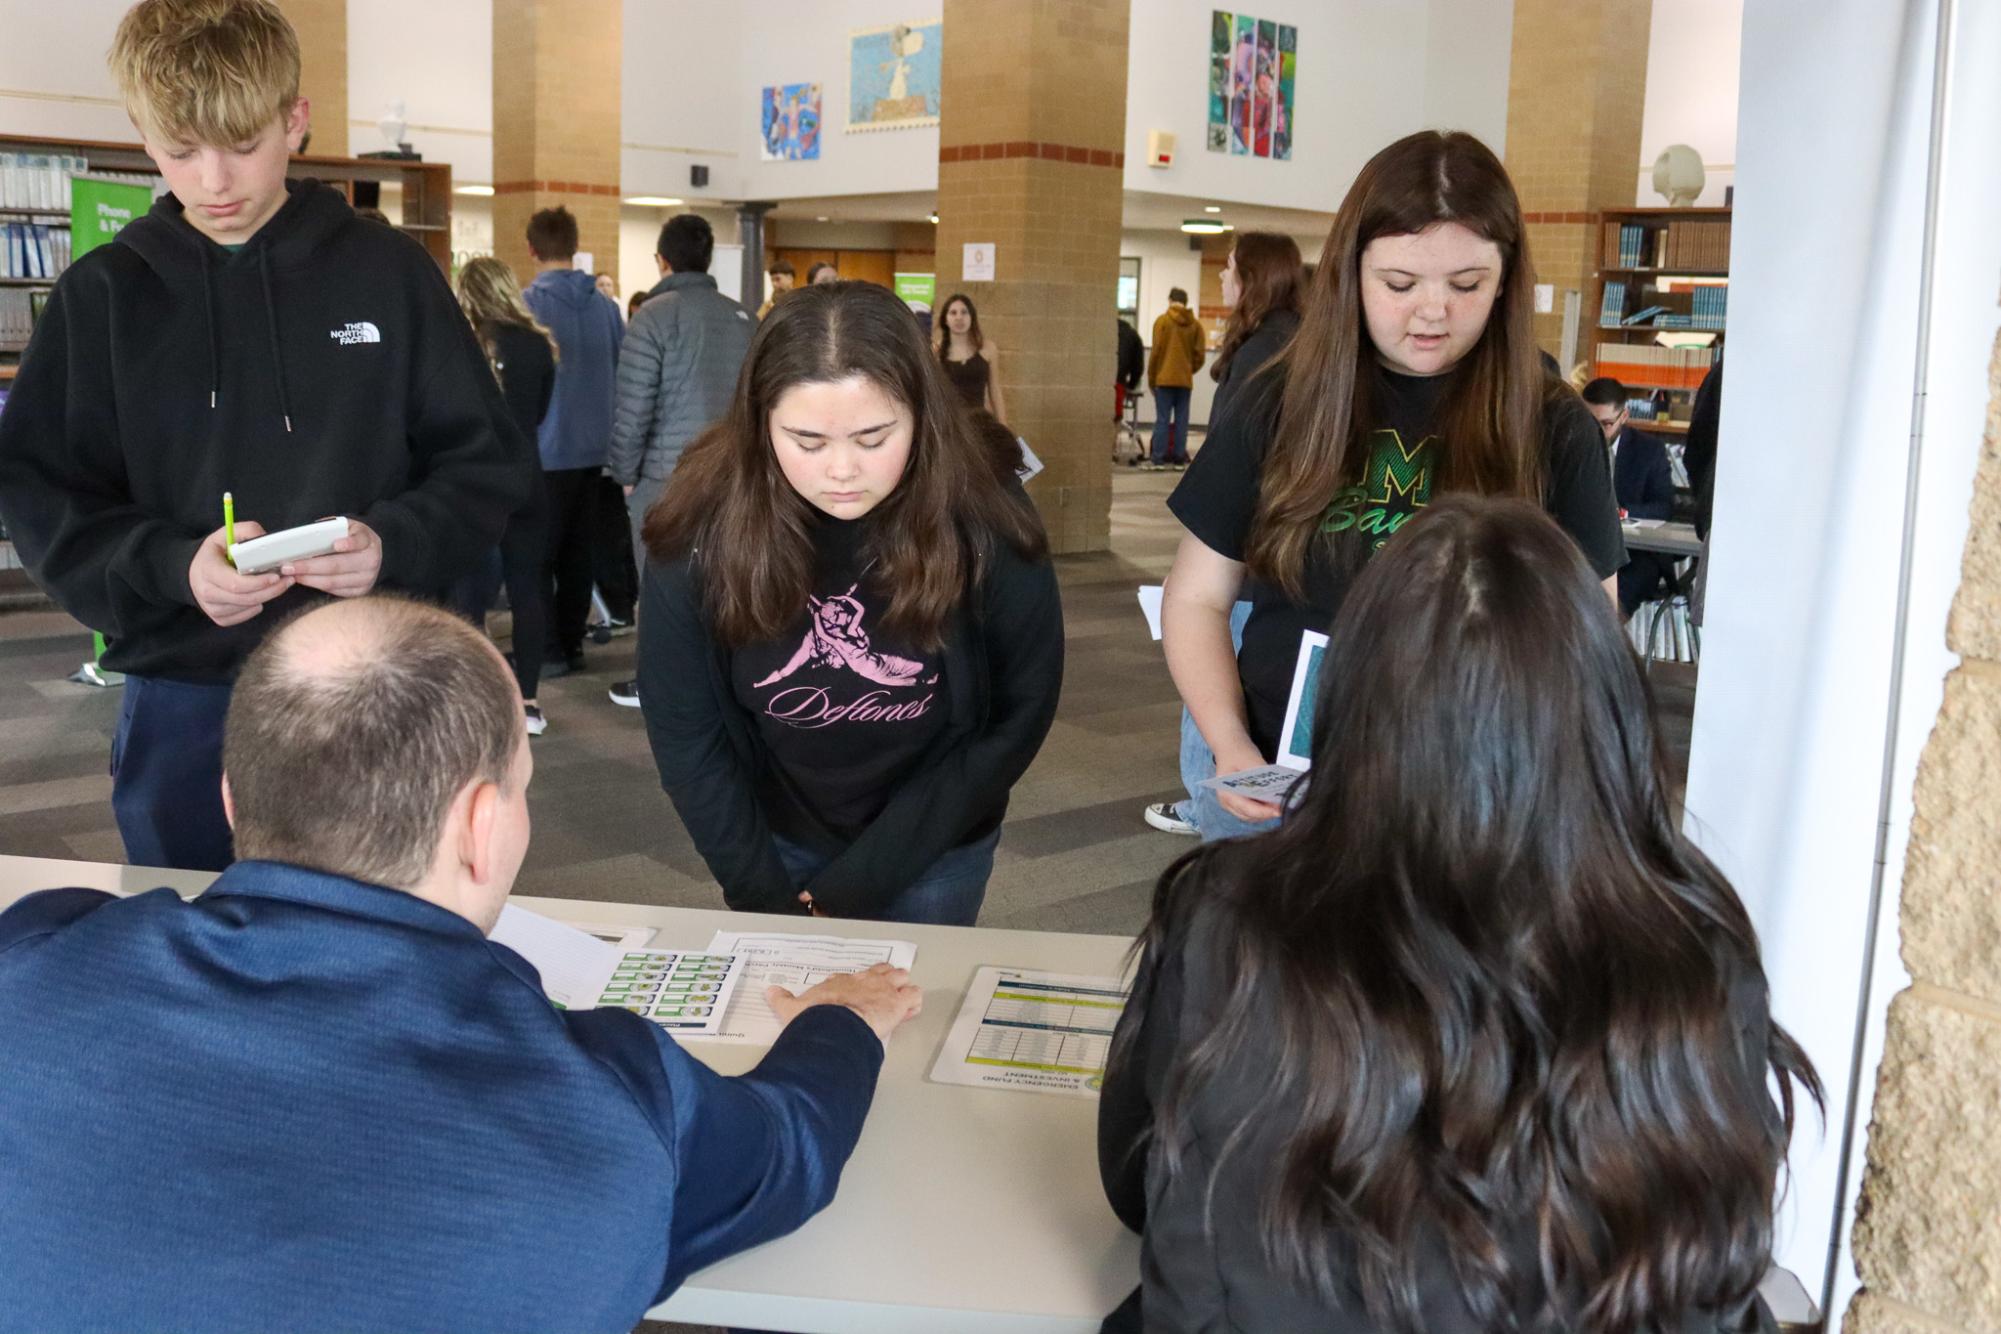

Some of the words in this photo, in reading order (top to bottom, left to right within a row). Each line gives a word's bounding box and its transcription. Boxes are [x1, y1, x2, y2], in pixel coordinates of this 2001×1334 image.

[344, 322, 363, 330] THE
[330, 330, 363, 339] NORTH
[340, 336, 364, 345] FACE
[1357, 428, 1443, 508] M
[765, 686, 934, 729] Deftones
[982, 1076, 1012, 1084] FUND
[1004, 1072, 1070, 1083] INVESTMENT
[1015, 1079, 1079, 1090] EMERGENCY
